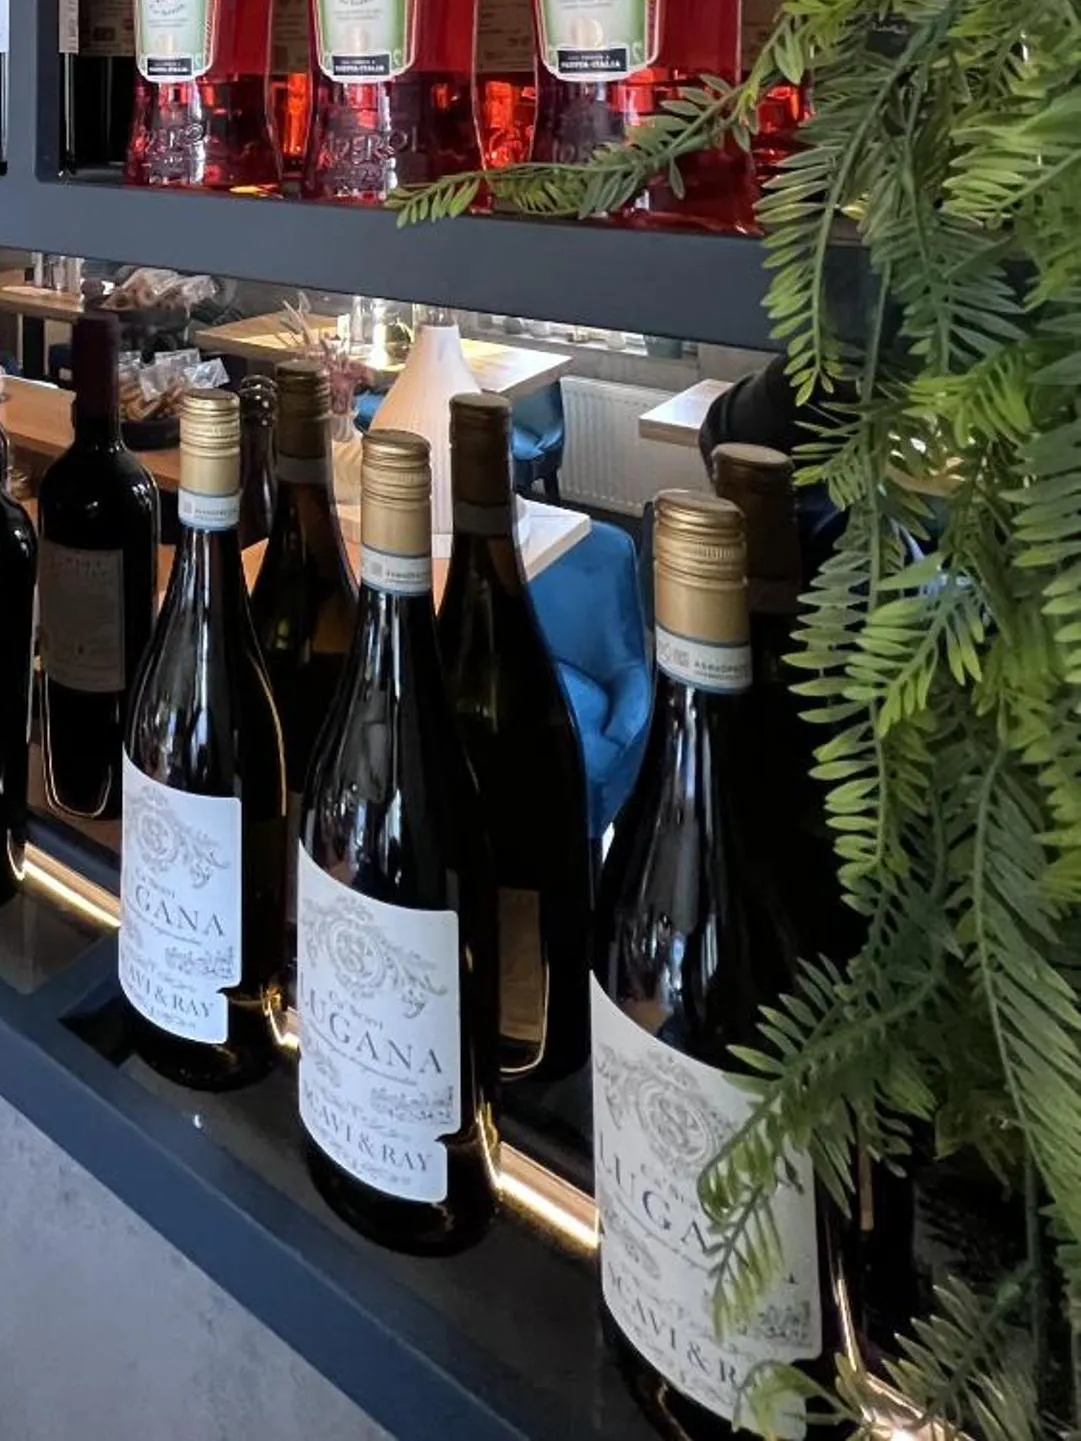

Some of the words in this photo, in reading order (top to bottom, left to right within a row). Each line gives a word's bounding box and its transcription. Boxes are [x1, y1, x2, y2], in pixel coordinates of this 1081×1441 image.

[133, 883, 225, 938] GANA
[171, 996, 216, 1019] RAY
[381, 1143, 433, 1173] RAY
